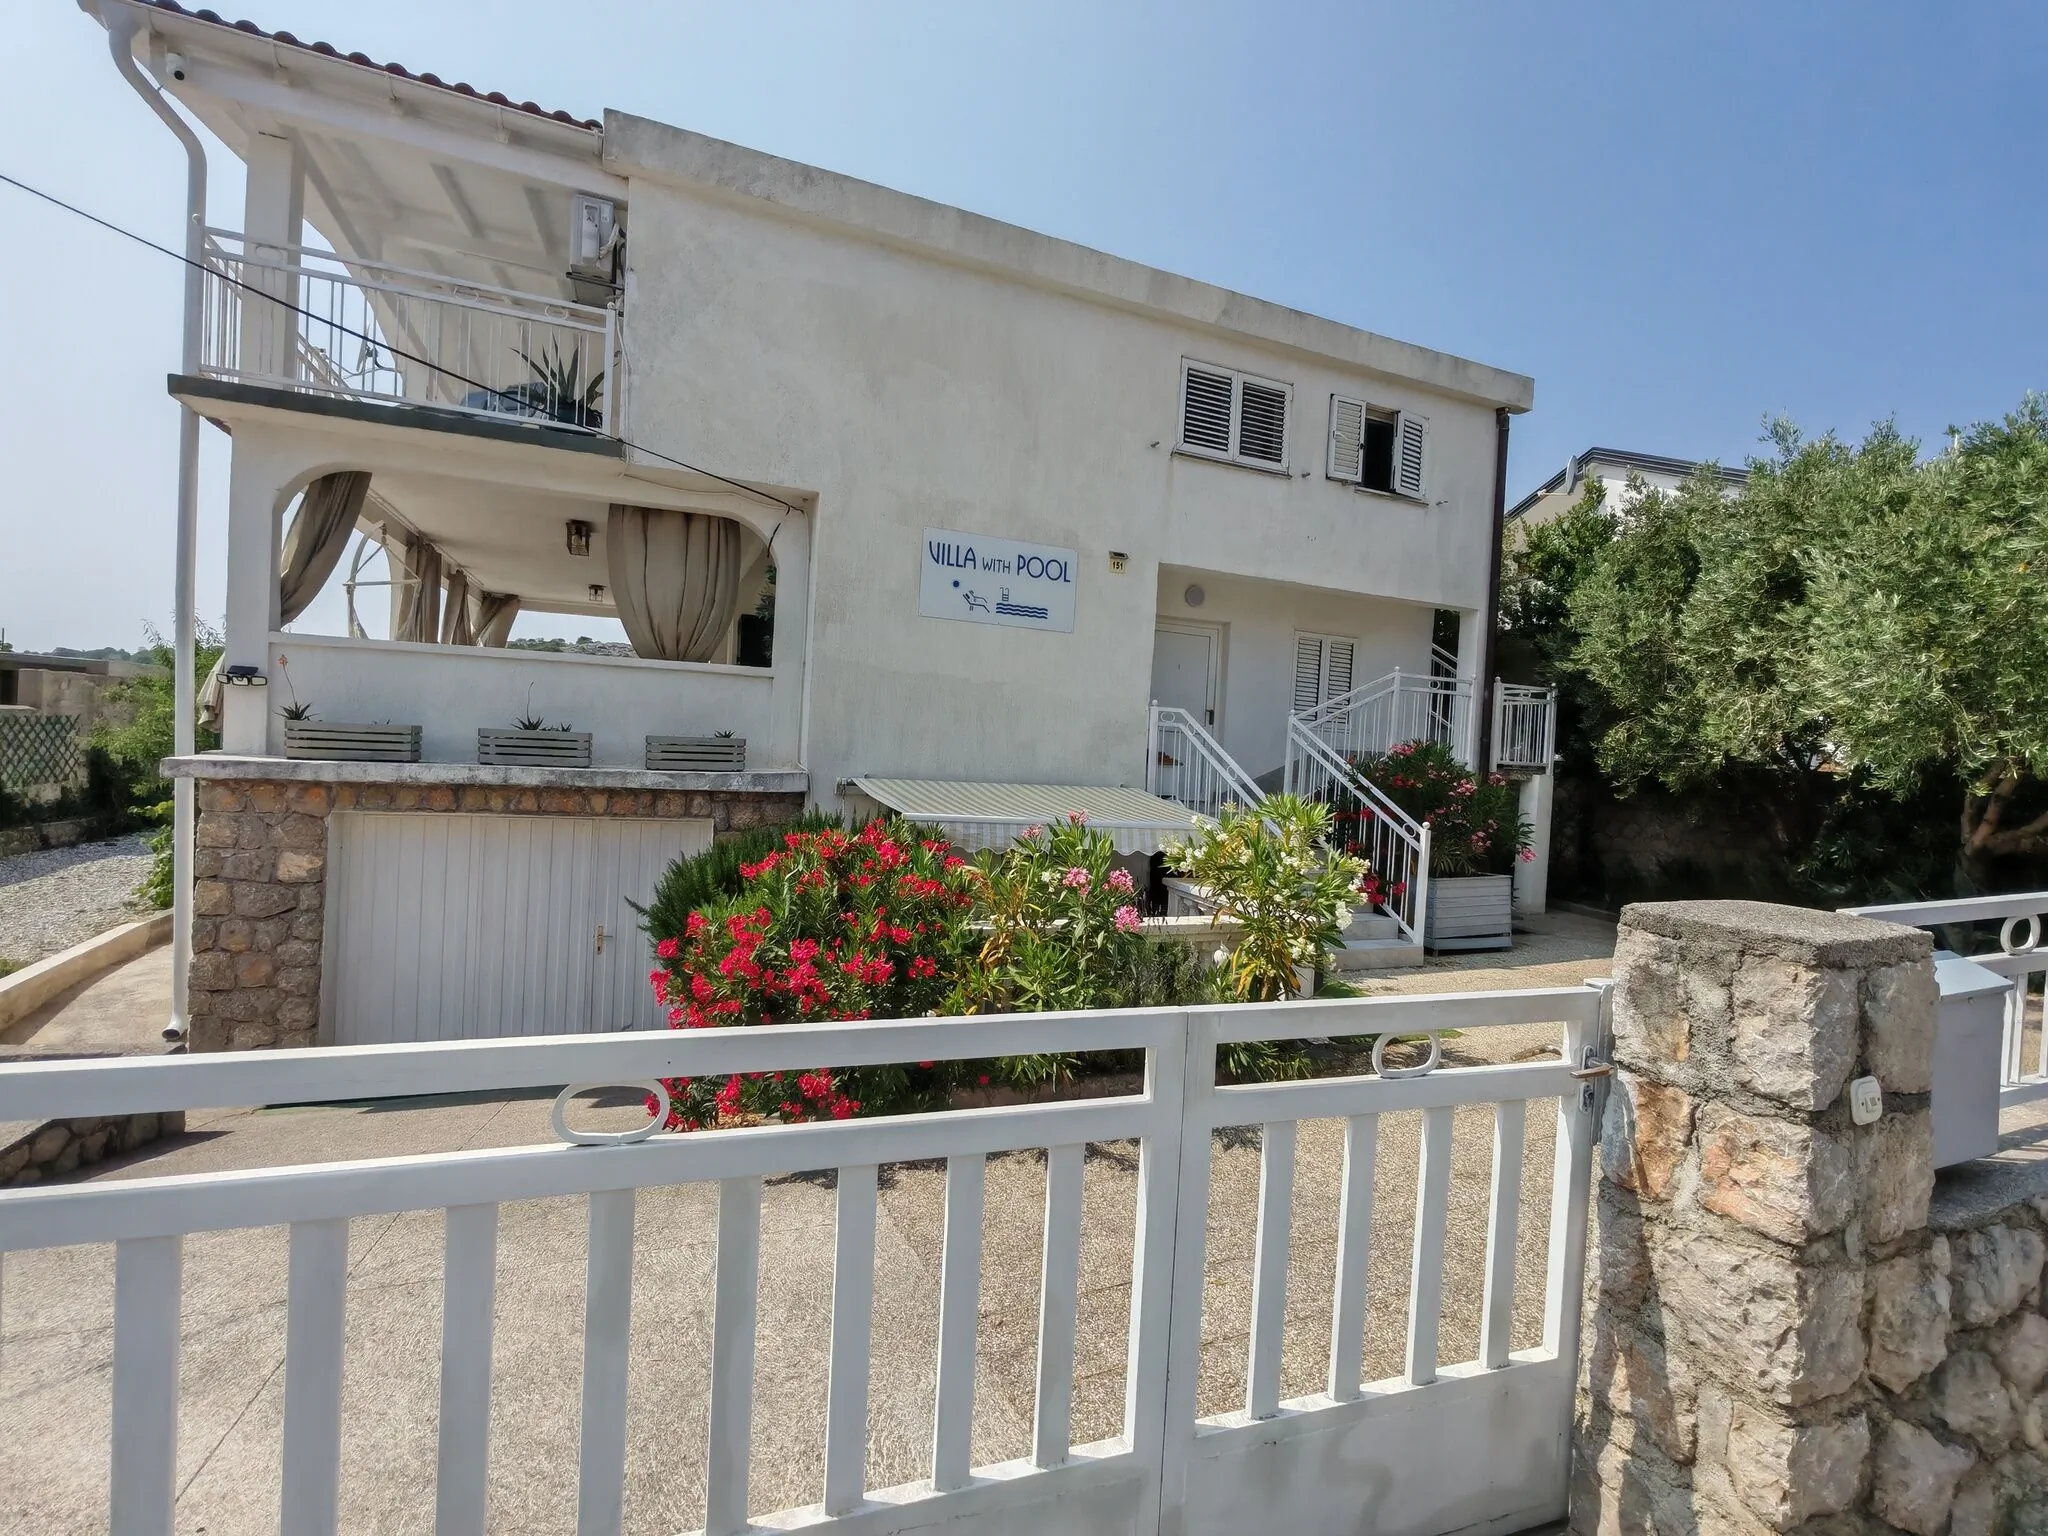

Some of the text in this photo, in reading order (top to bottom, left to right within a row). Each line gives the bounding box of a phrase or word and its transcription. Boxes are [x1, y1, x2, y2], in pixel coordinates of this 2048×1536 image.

[928, 540, 1071, 583] VILLA WITH POOL
[1112, 560, 1124, 571] 151
